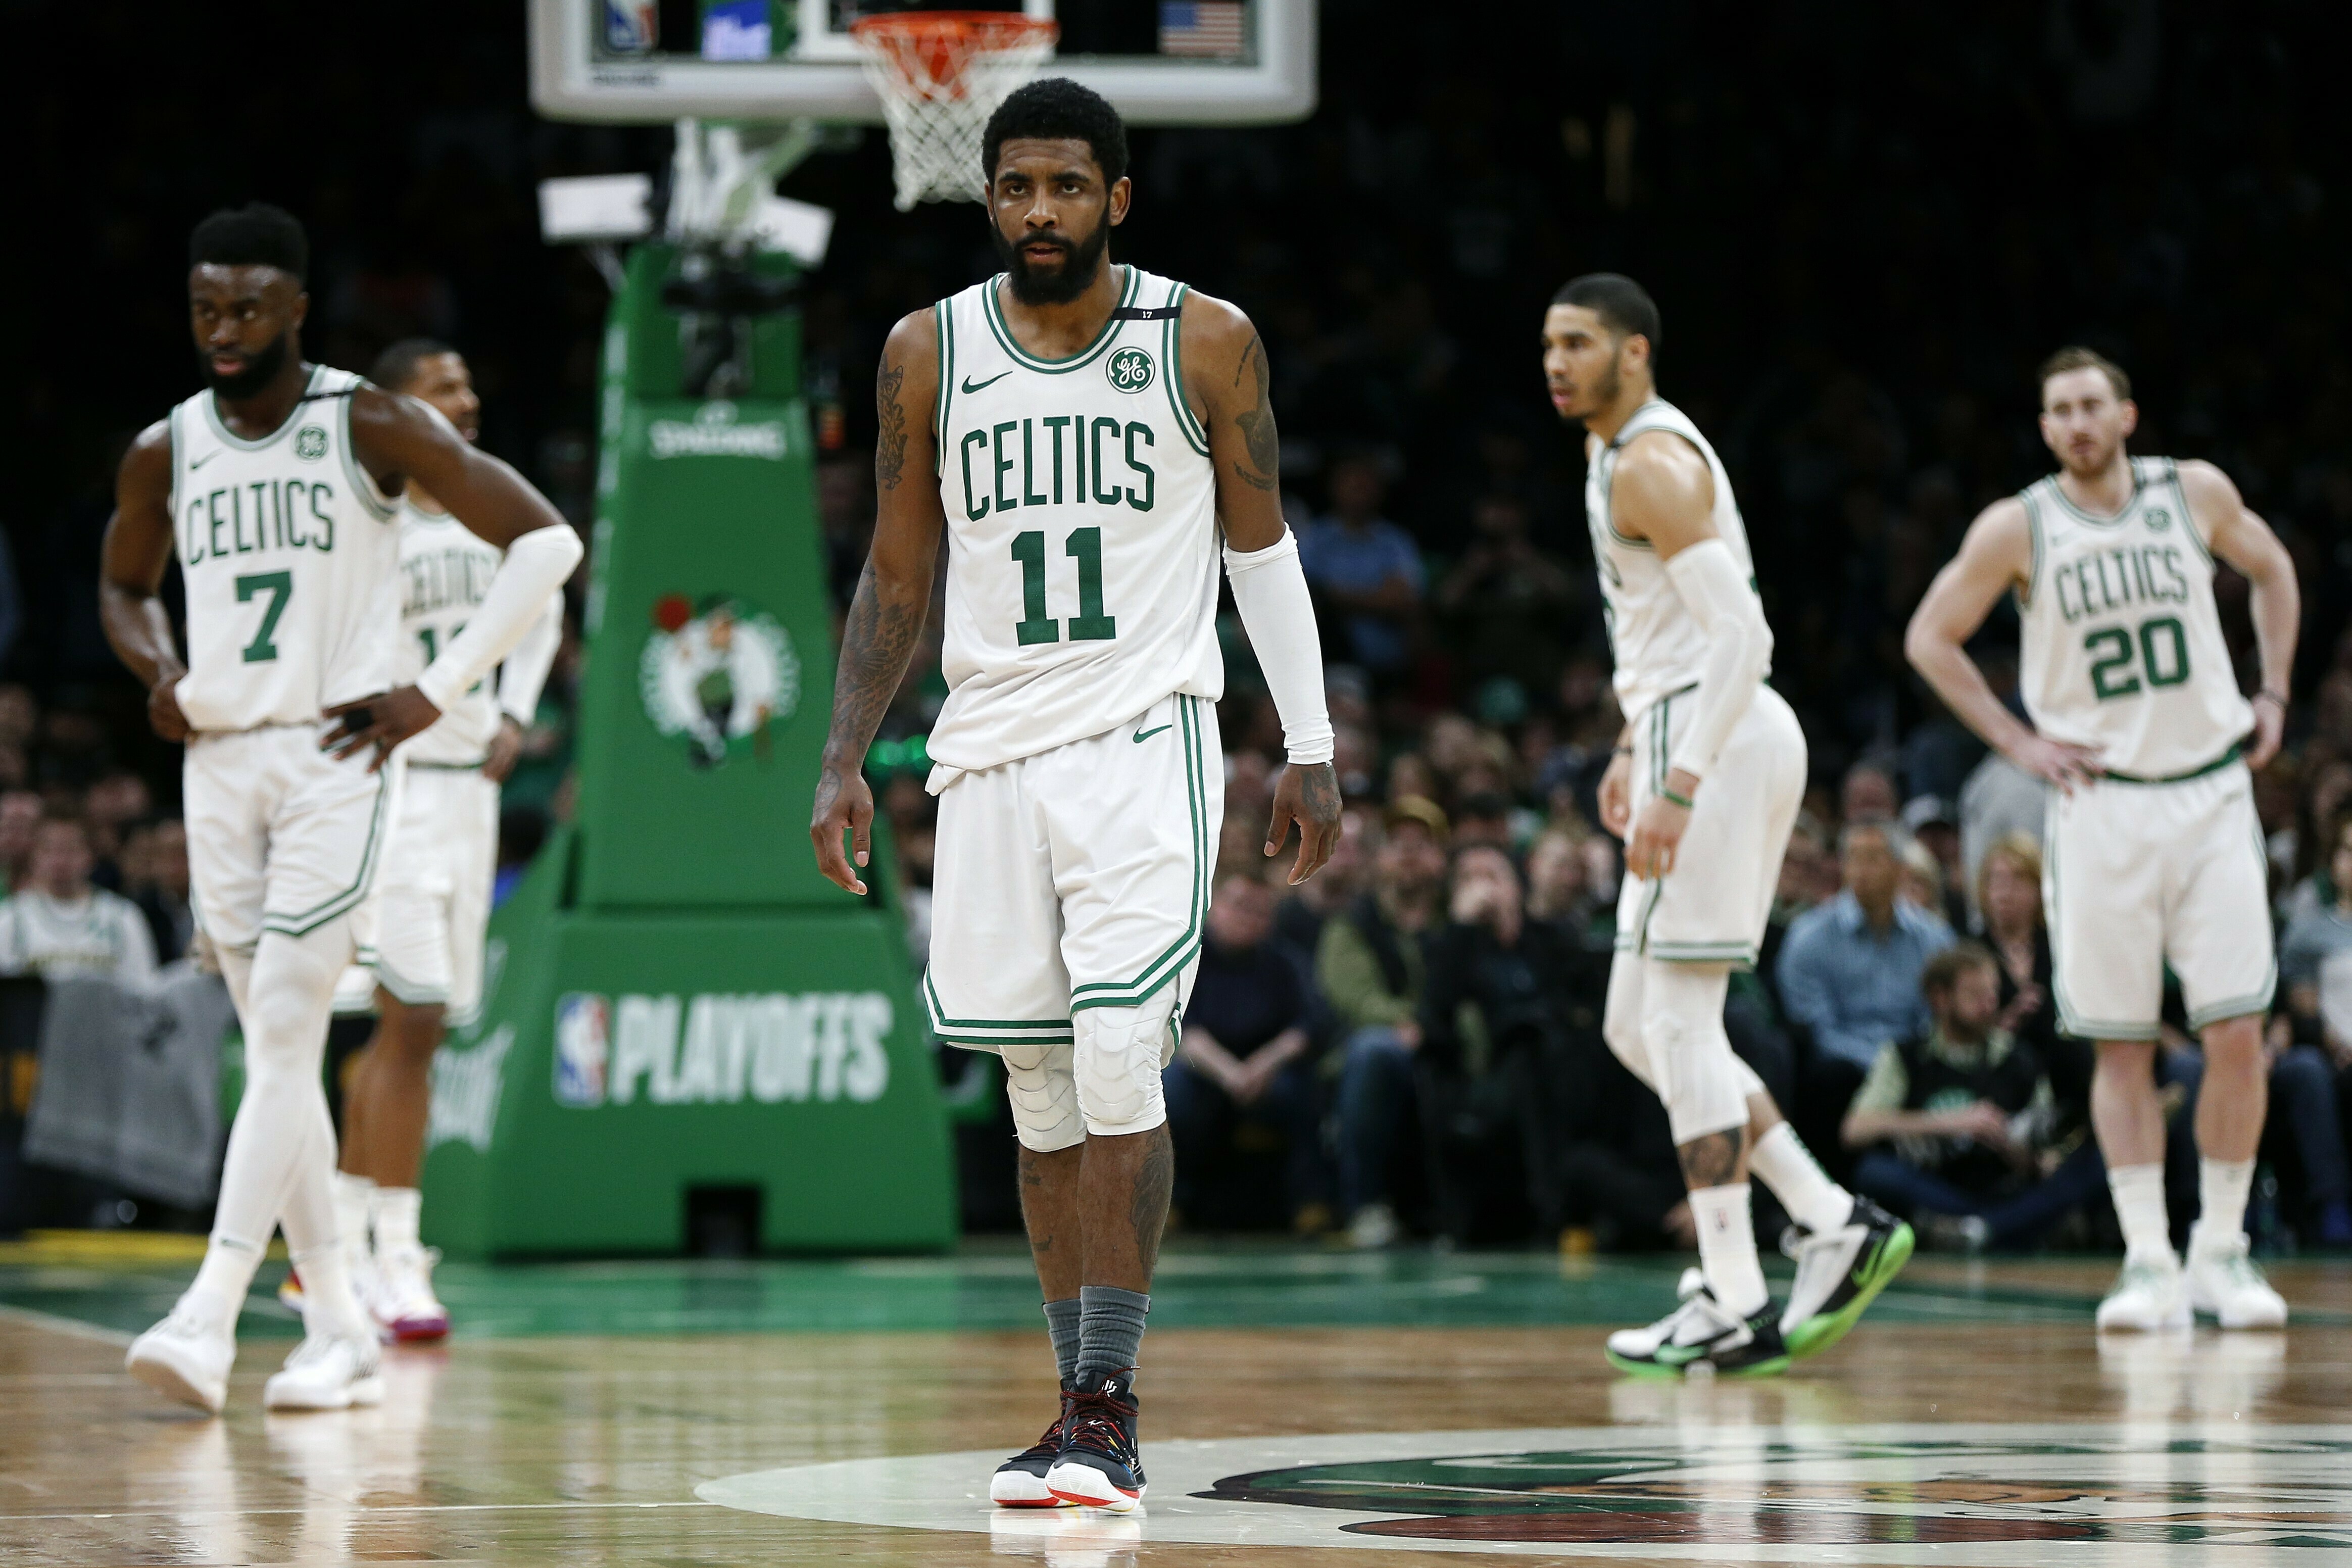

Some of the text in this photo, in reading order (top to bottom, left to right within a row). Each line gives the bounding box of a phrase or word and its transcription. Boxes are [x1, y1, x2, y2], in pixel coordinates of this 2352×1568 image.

[1142, 311, 1152, 319] 17
[960, 415, 1155, 522] CELTICS
[186, 478, 335, 567] CELTICS
[234, 570, 292, 664] 7
[1010, 526, 1116, 647] 11
[2054, 544, 2189, 625] CELTICS
[2084, 616, 2190, 700] 20
[610, 991, 893, 1104] PLAYOFFS
